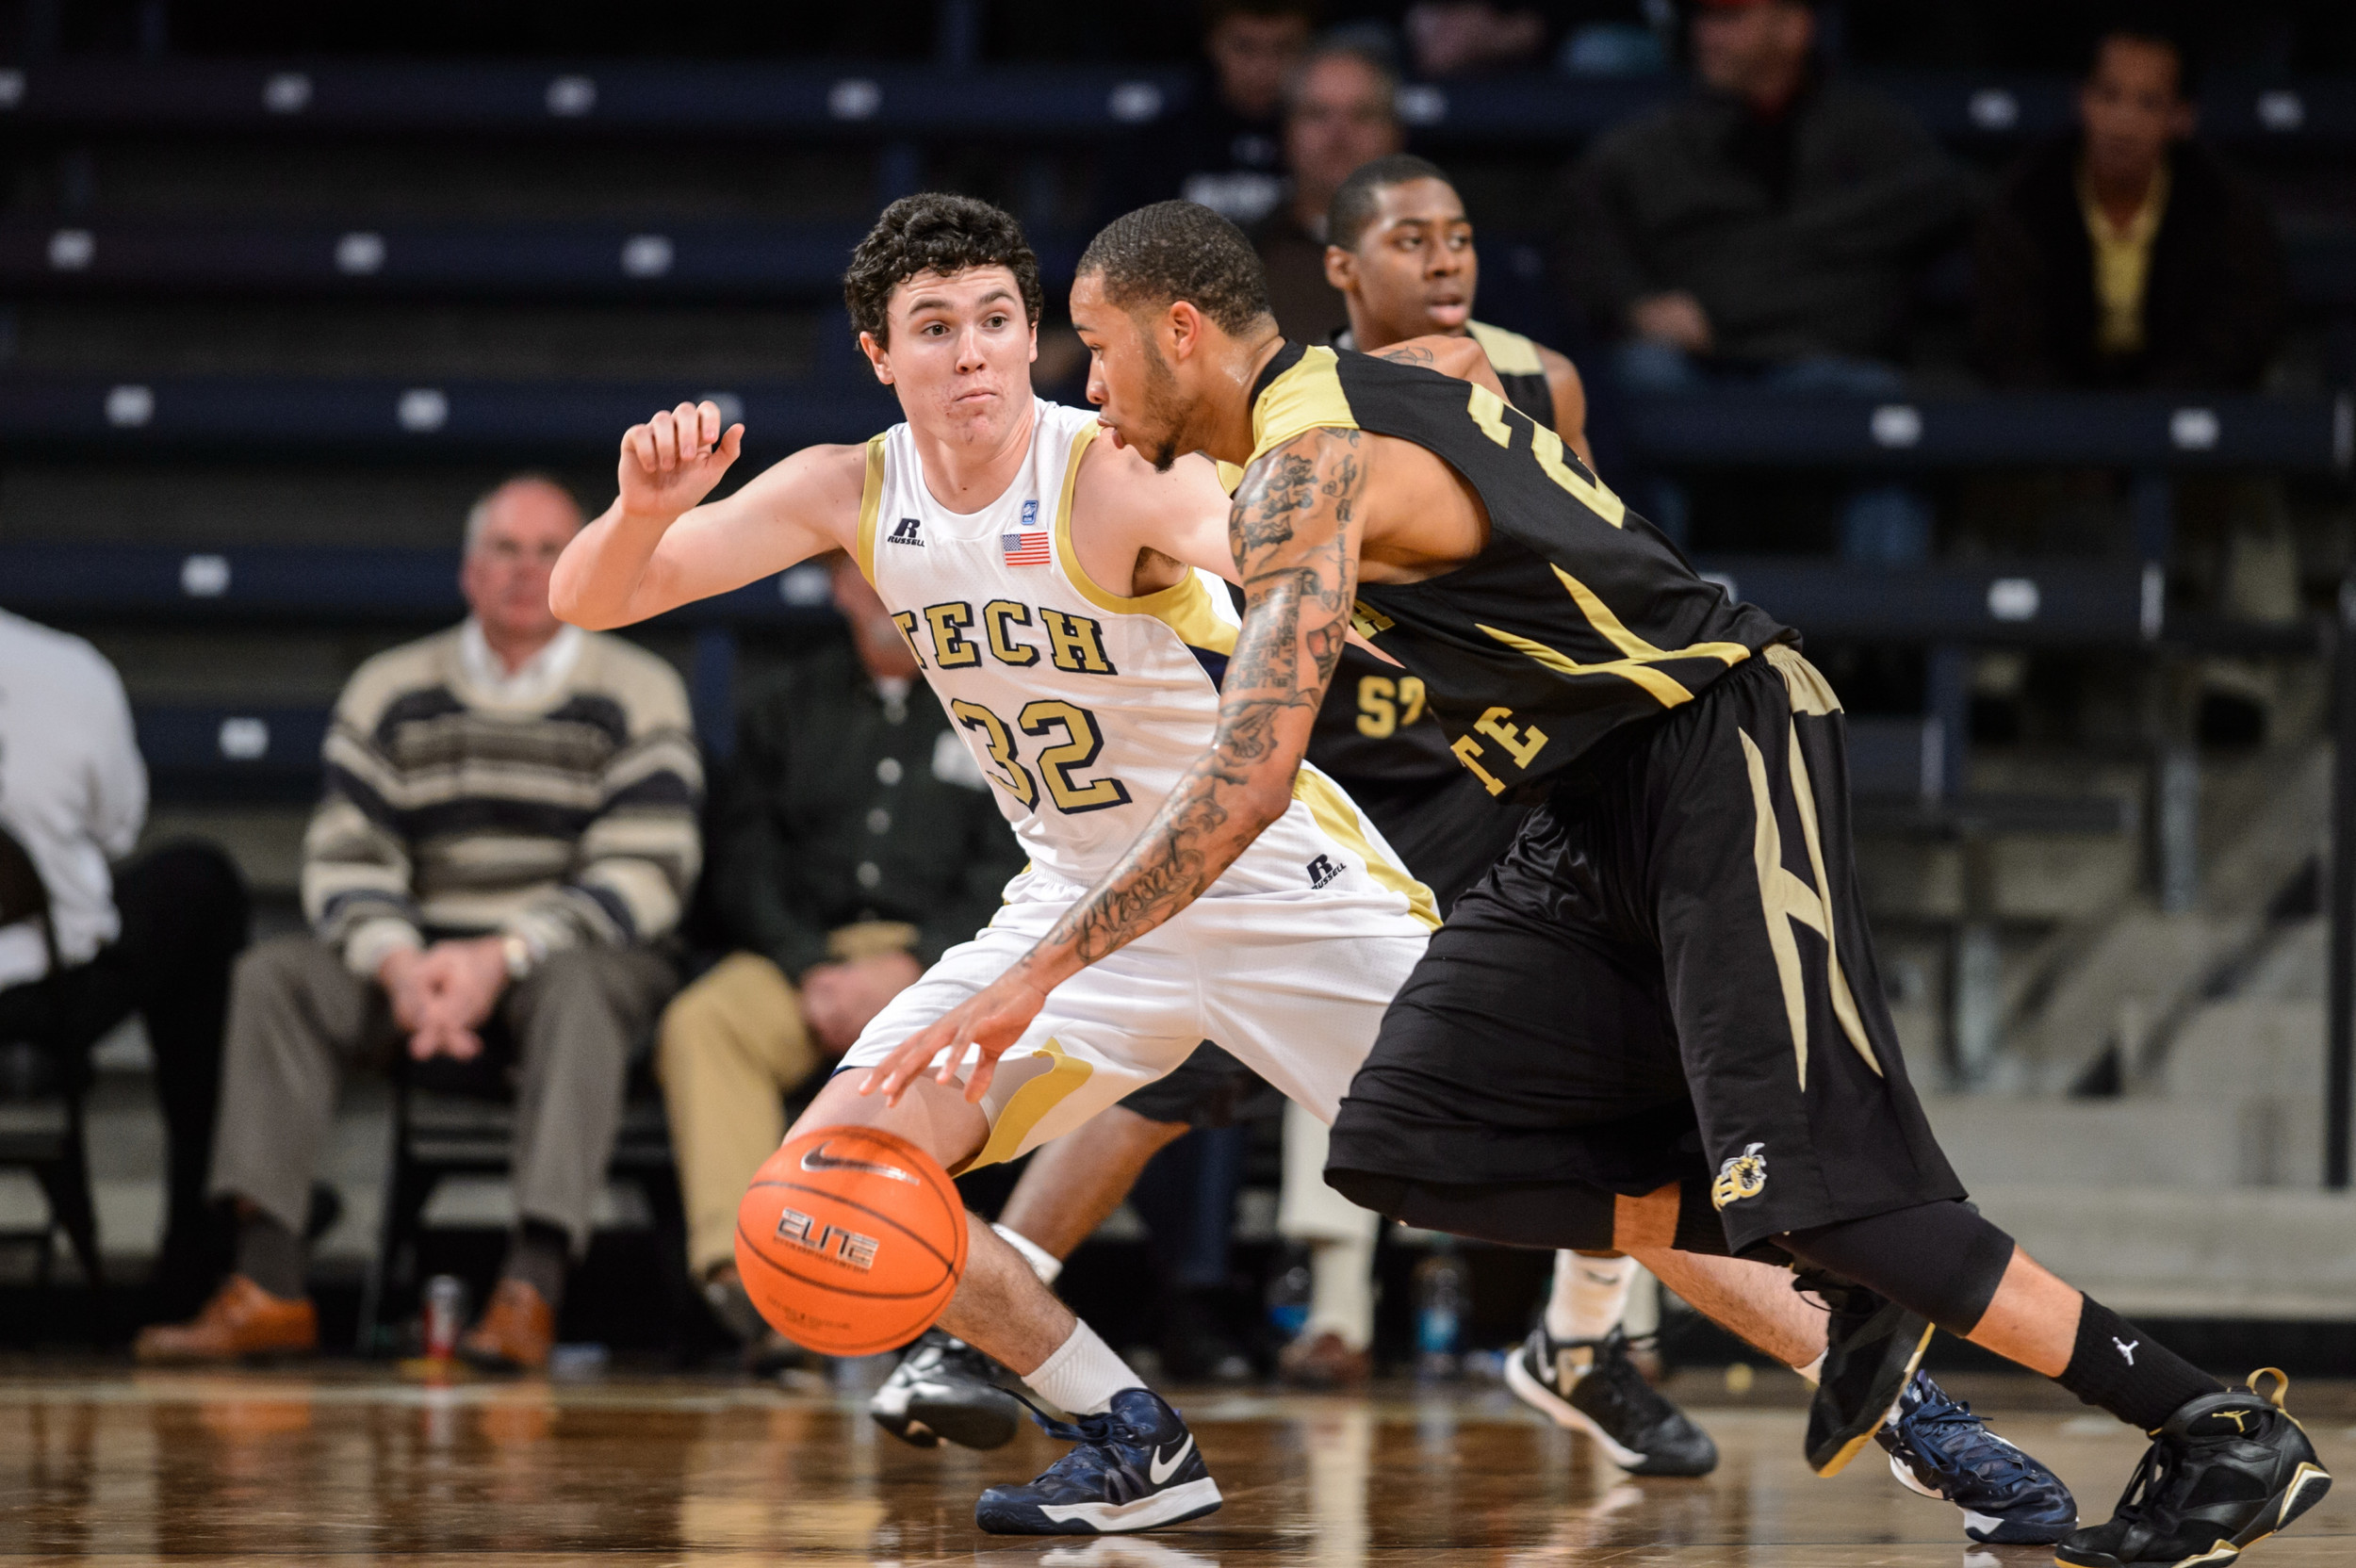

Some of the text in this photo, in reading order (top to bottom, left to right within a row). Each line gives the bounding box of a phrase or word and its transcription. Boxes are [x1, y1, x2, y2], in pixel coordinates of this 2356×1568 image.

[887, 535, 925, 547] RUSSELL
[893, 517, 921, 538] R
[951, 698, 1133, 815] 32
[1306, 853, 1333, 885] R
[1311, 862, 1347, 890] RUSSELL
[776, 1206, 879, 1270] ELITE
